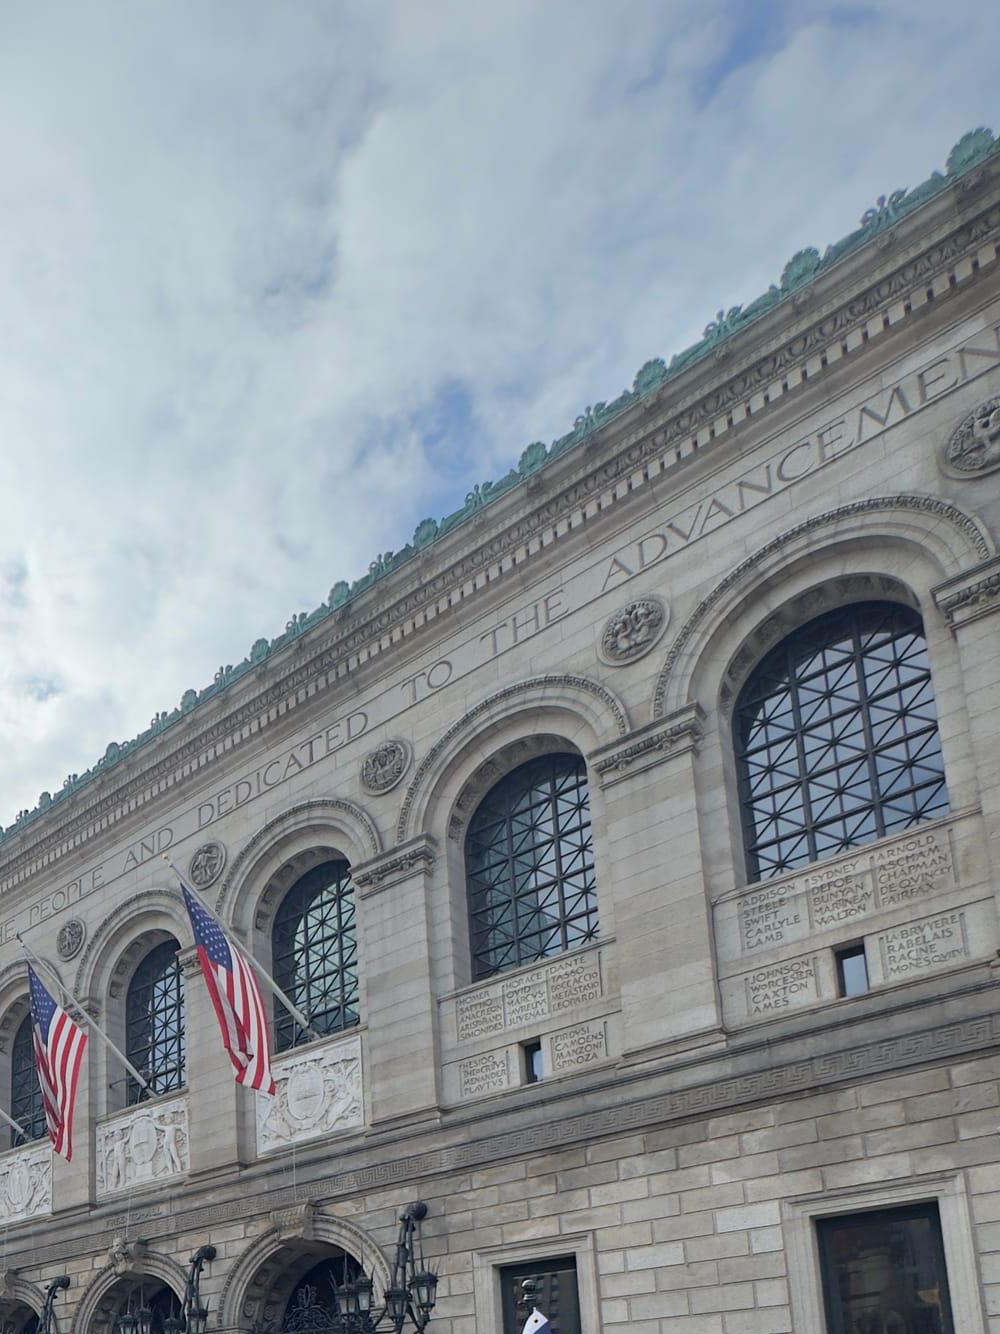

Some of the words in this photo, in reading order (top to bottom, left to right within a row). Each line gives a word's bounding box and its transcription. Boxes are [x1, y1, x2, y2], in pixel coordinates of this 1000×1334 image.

[29, 866, 105, 927] PEOPLE
[122, 827, 175, 873] AND
[196, 711, 369, 828] DEDICATED
[402, 660, 453, 702] TO
[480, 589, 570, 657] THE
[877, 835, 935, 861] ARNOLD
[879, 845, 940, 872] ASCHAM
[811, 860, 860, 885] SYDNEY
[879, 854, 948, 884] CHAPMAN
[743, 882, 796, 908] ADDISON
[812, 874, 853, 896] DEFOE
[813, 882, 864, 906] BUNYAN
[880, 883, 897, 895] DE
[881, 882, 936, 906] FAIRFAX
[743, 897, 787, 919] STEELE
[815, 903, 866, 926] WALTON
[744, 910, 779, 929] SWIFT
[745, 913, 801, 939] CARLYLE
[746, 931, 784, 949] LAMB
[887, 927, 953, 955] RABELAIS
[888, 943, 937, 965] RACINE
[550, 956, 587, 975] DANTE
[552, 966, 585, 984] TASSO
[751, 959, 810, 985] JOHNSON
[505, 972, 543, 988] HORACE
[460, 990, 490, 1005] HOMER
[506, 985, 531, 999] OVID
[552, 990, 598, 1012] LEOPARDI
[752, 981, 808, 1004] CAXTON
[460, 998, 493, 1015] SAPPHO
[753, 996, 790, 1015] AMES
[461, 1022, 504, 1040] SIMONIDES
[555, 1031, 604, 1052] CAMOENS
[462, 1054, 495, 1070] HESIOD
[556, 1042, 603, 1061] MANZONI
[556, 1052, 599, 1070] SPINOZA
[463, 1069, 506, 1086] MENANDER
